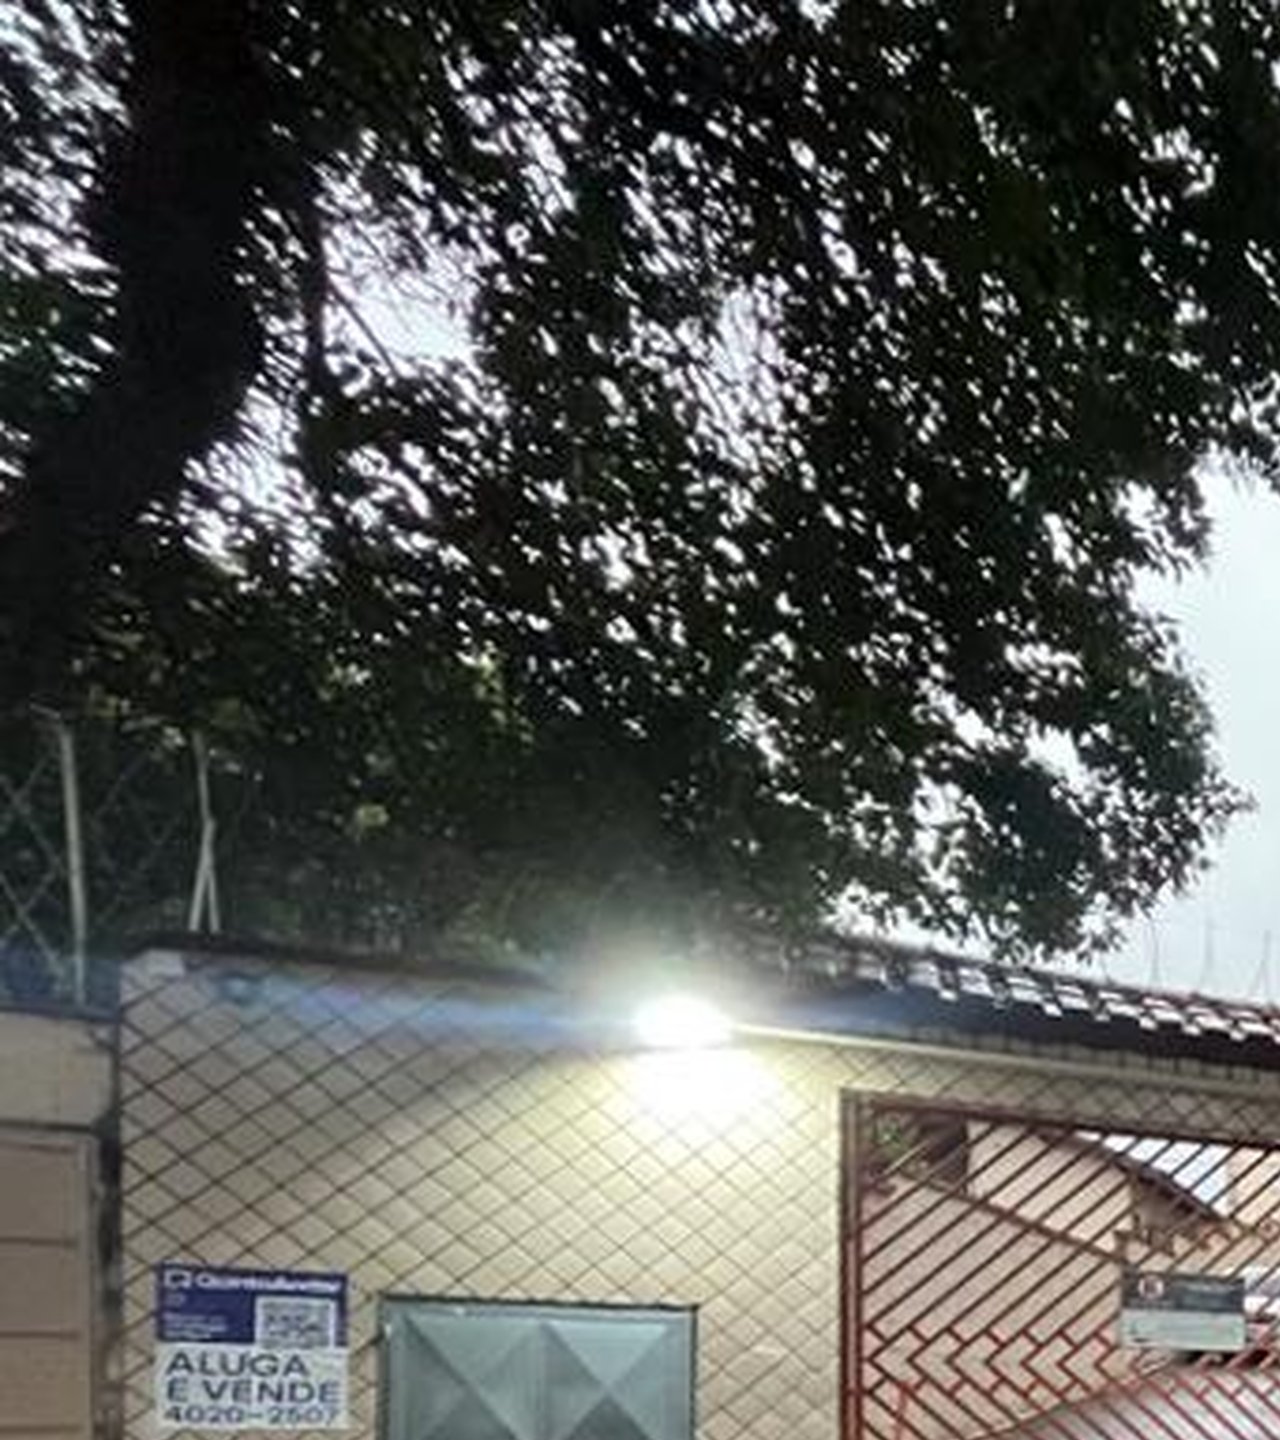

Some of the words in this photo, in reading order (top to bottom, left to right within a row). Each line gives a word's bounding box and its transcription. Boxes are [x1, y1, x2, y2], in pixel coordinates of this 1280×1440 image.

[165, 1351, 310, 1377] ALUGA
[167, 1377, 188, 1402] E
[202, 1380, 341, 1404] VENDE
[163, 1405, 340, 1426] 4020-2507
